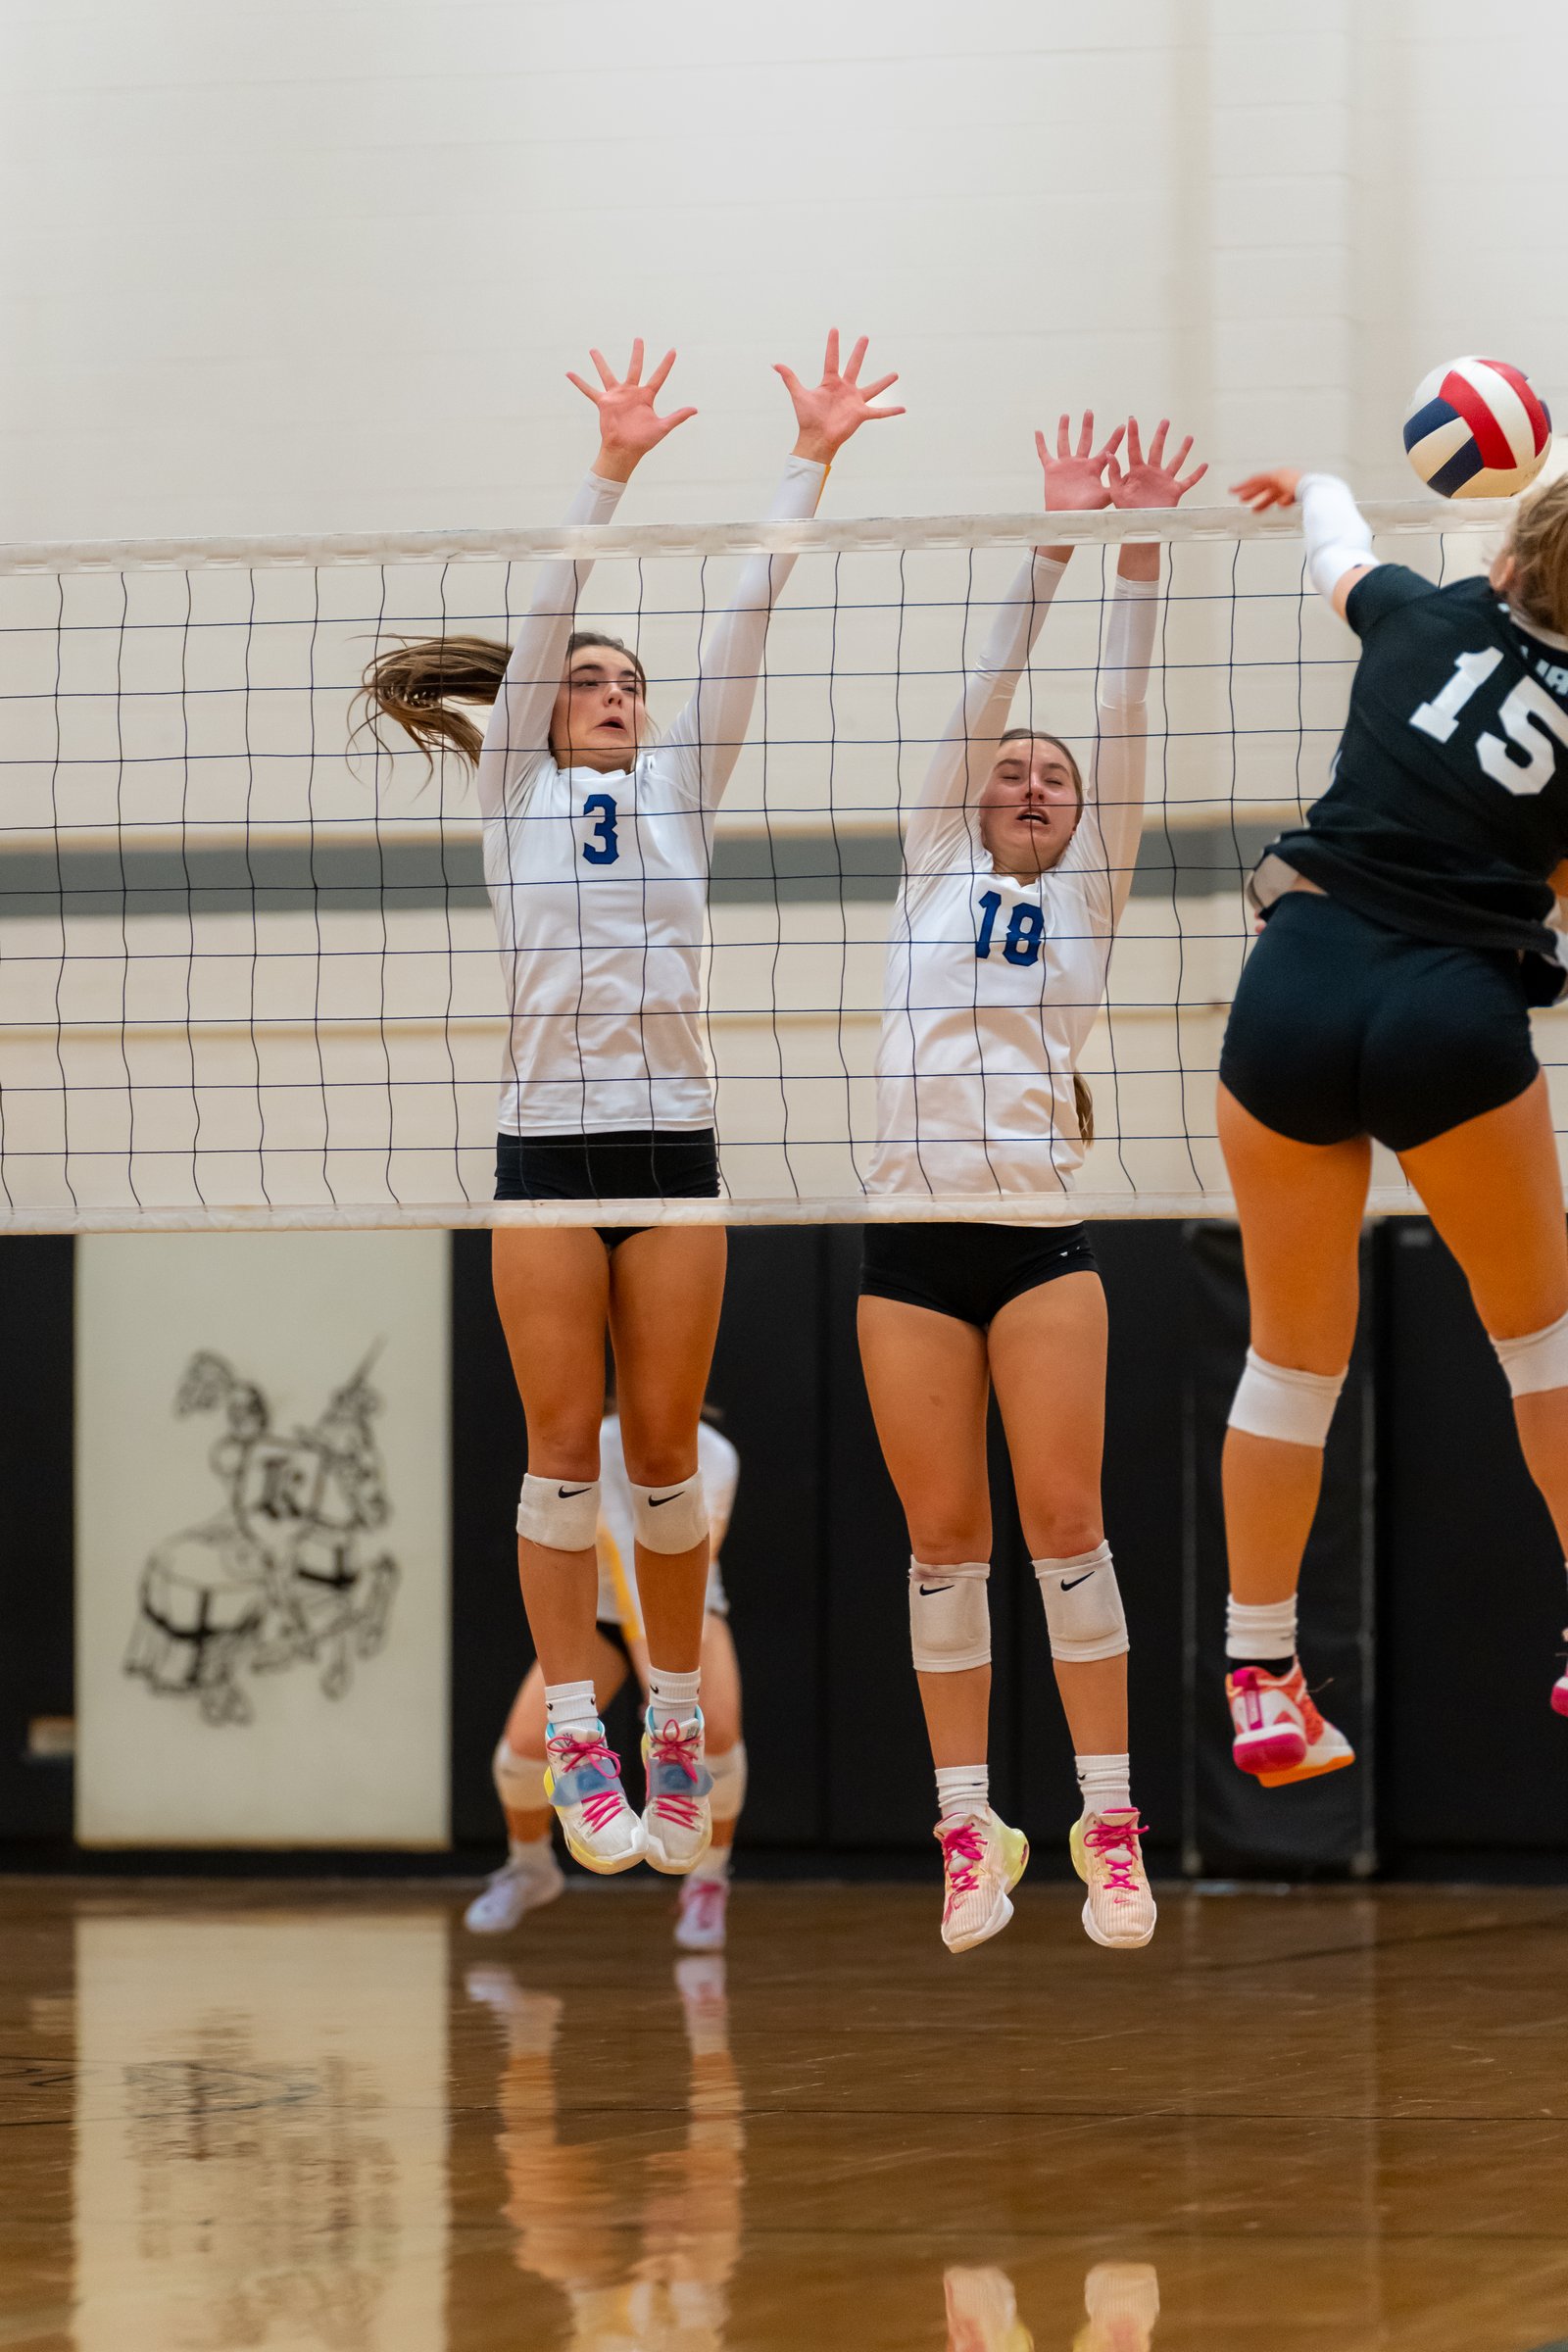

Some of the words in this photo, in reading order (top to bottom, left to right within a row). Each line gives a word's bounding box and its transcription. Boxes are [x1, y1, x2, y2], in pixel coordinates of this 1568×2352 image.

[1408, 645, 1568, 796] 15
[582, 793, 619, 864] 3
[975, 890, 1045, 967] 18
